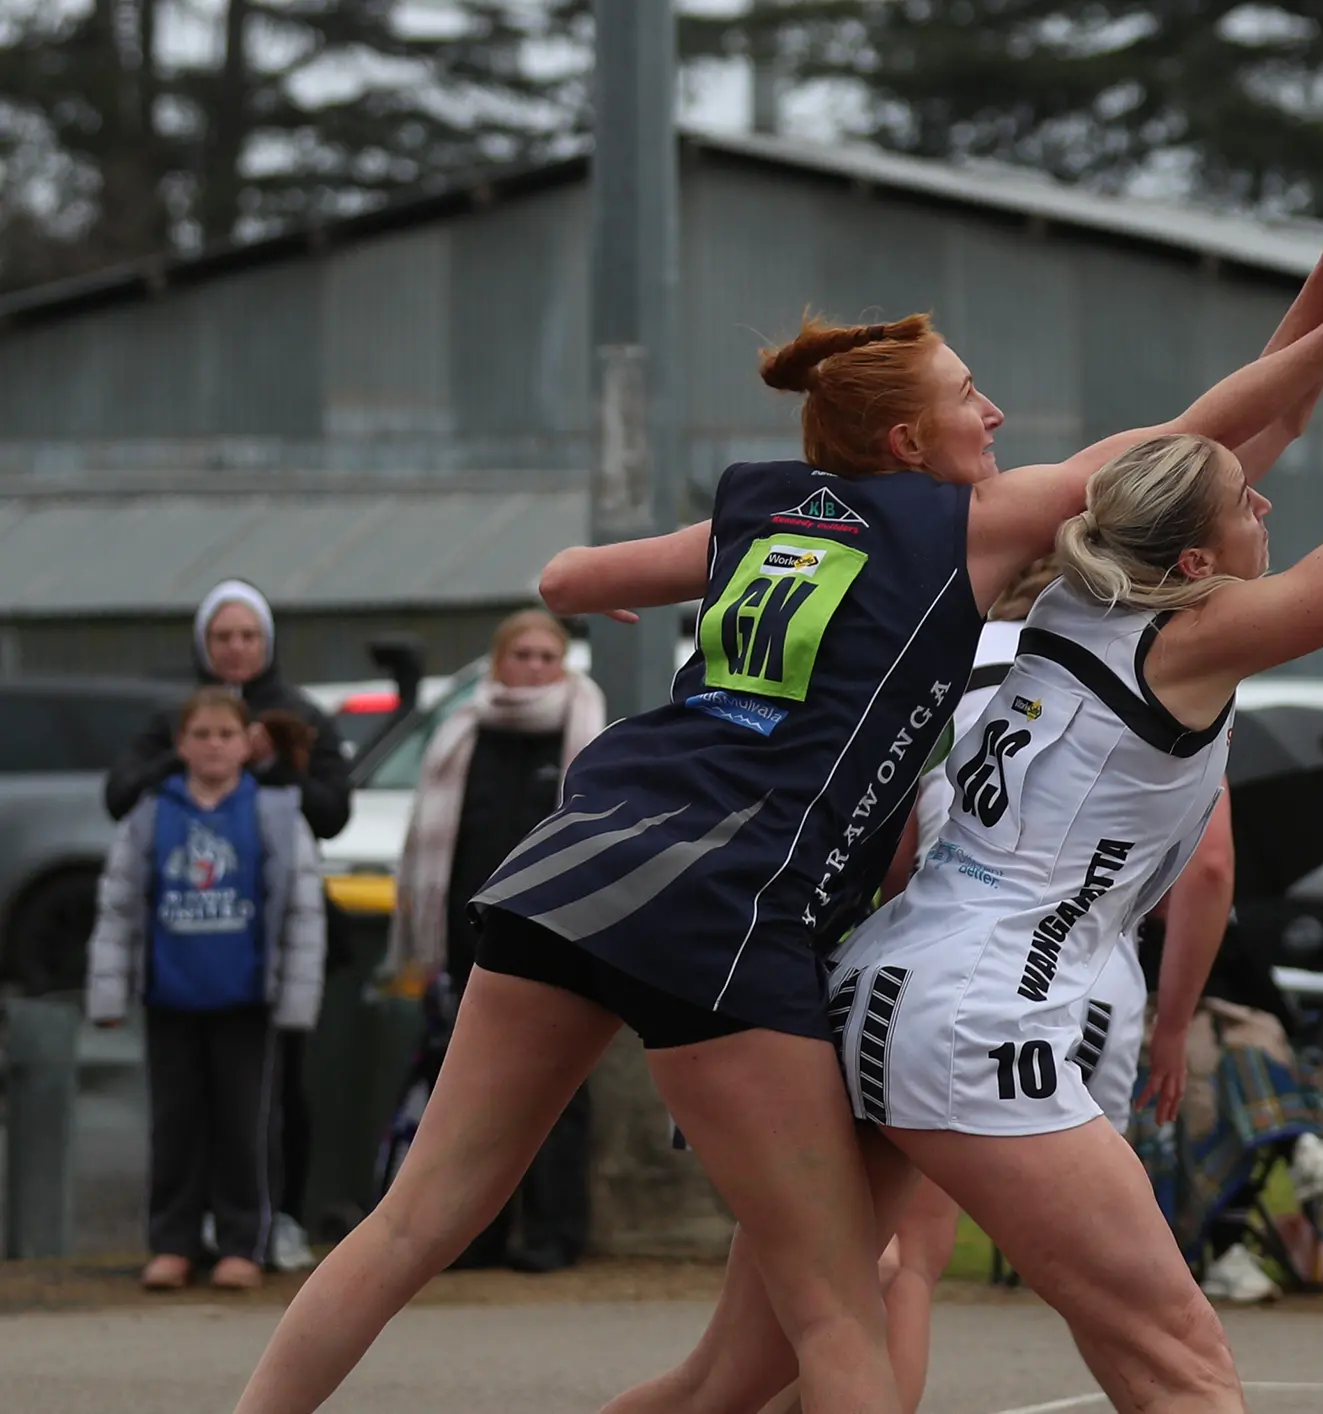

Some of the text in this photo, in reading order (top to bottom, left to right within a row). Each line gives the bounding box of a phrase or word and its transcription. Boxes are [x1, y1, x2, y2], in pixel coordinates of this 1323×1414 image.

[825, 502, 836, 517] B
[721, 576, 819, 683] GK
[957, 719, 1032, 828] GS
[988, 1040, 1057, 1099] 10
